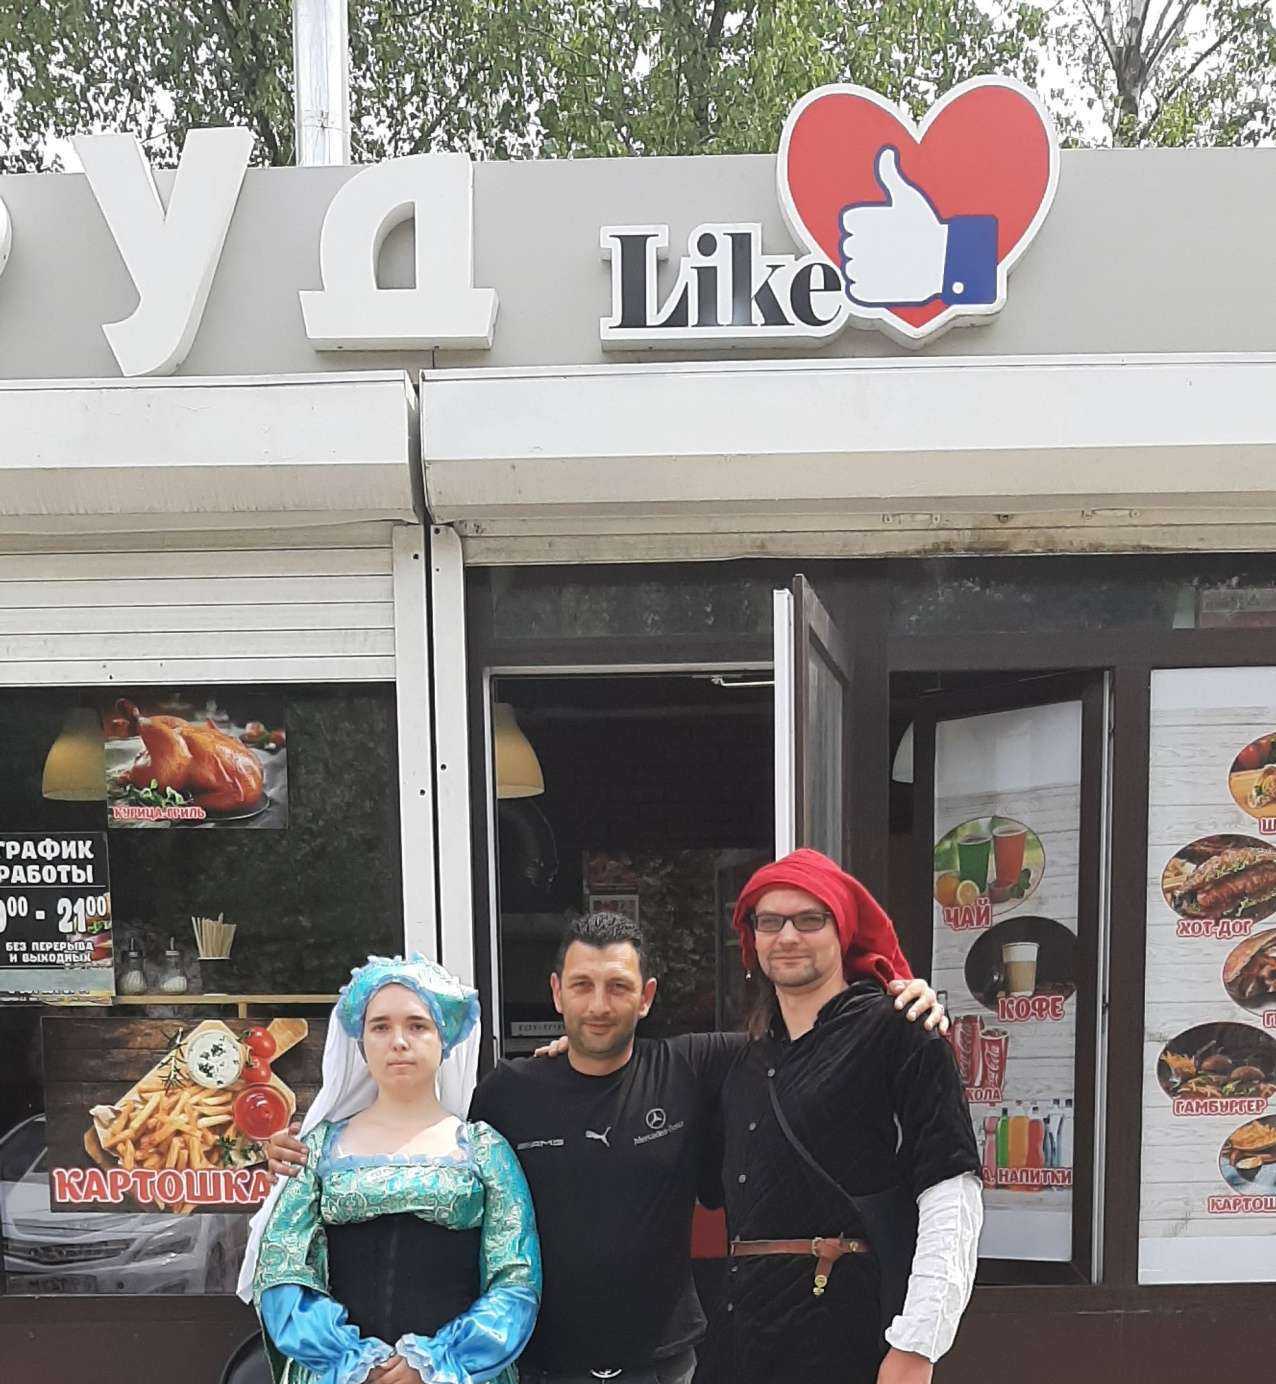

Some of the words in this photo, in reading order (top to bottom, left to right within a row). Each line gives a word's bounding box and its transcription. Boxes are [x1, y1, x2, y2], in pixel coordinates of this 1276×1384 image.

[0, 128, 499, 377] УД
[608, 231, 843, 329] Like
[0, 865, 94, 884] РАБОТЫ
[943, 897, 992, 931] ЧАЙ
[1177, 918, 1252, 939] ХОТ-ДОГ
[5, 941, 27, 952] БЕЗ
[31, 941, 94, 952] ПЕРЕРЫВА
[9, 953, 18, 963] И
[22, 953, 92, 965] ВЫХОДНЫХ
[998, 995, 1066, 1021] КОФЕ
[1174, 1098, 1268, 1117] ГАМБУРГЕР
[53, 1168, 272, 1205] КАРТОШКА
[998, 1167, 1073, 1186] НАПИТКИ
